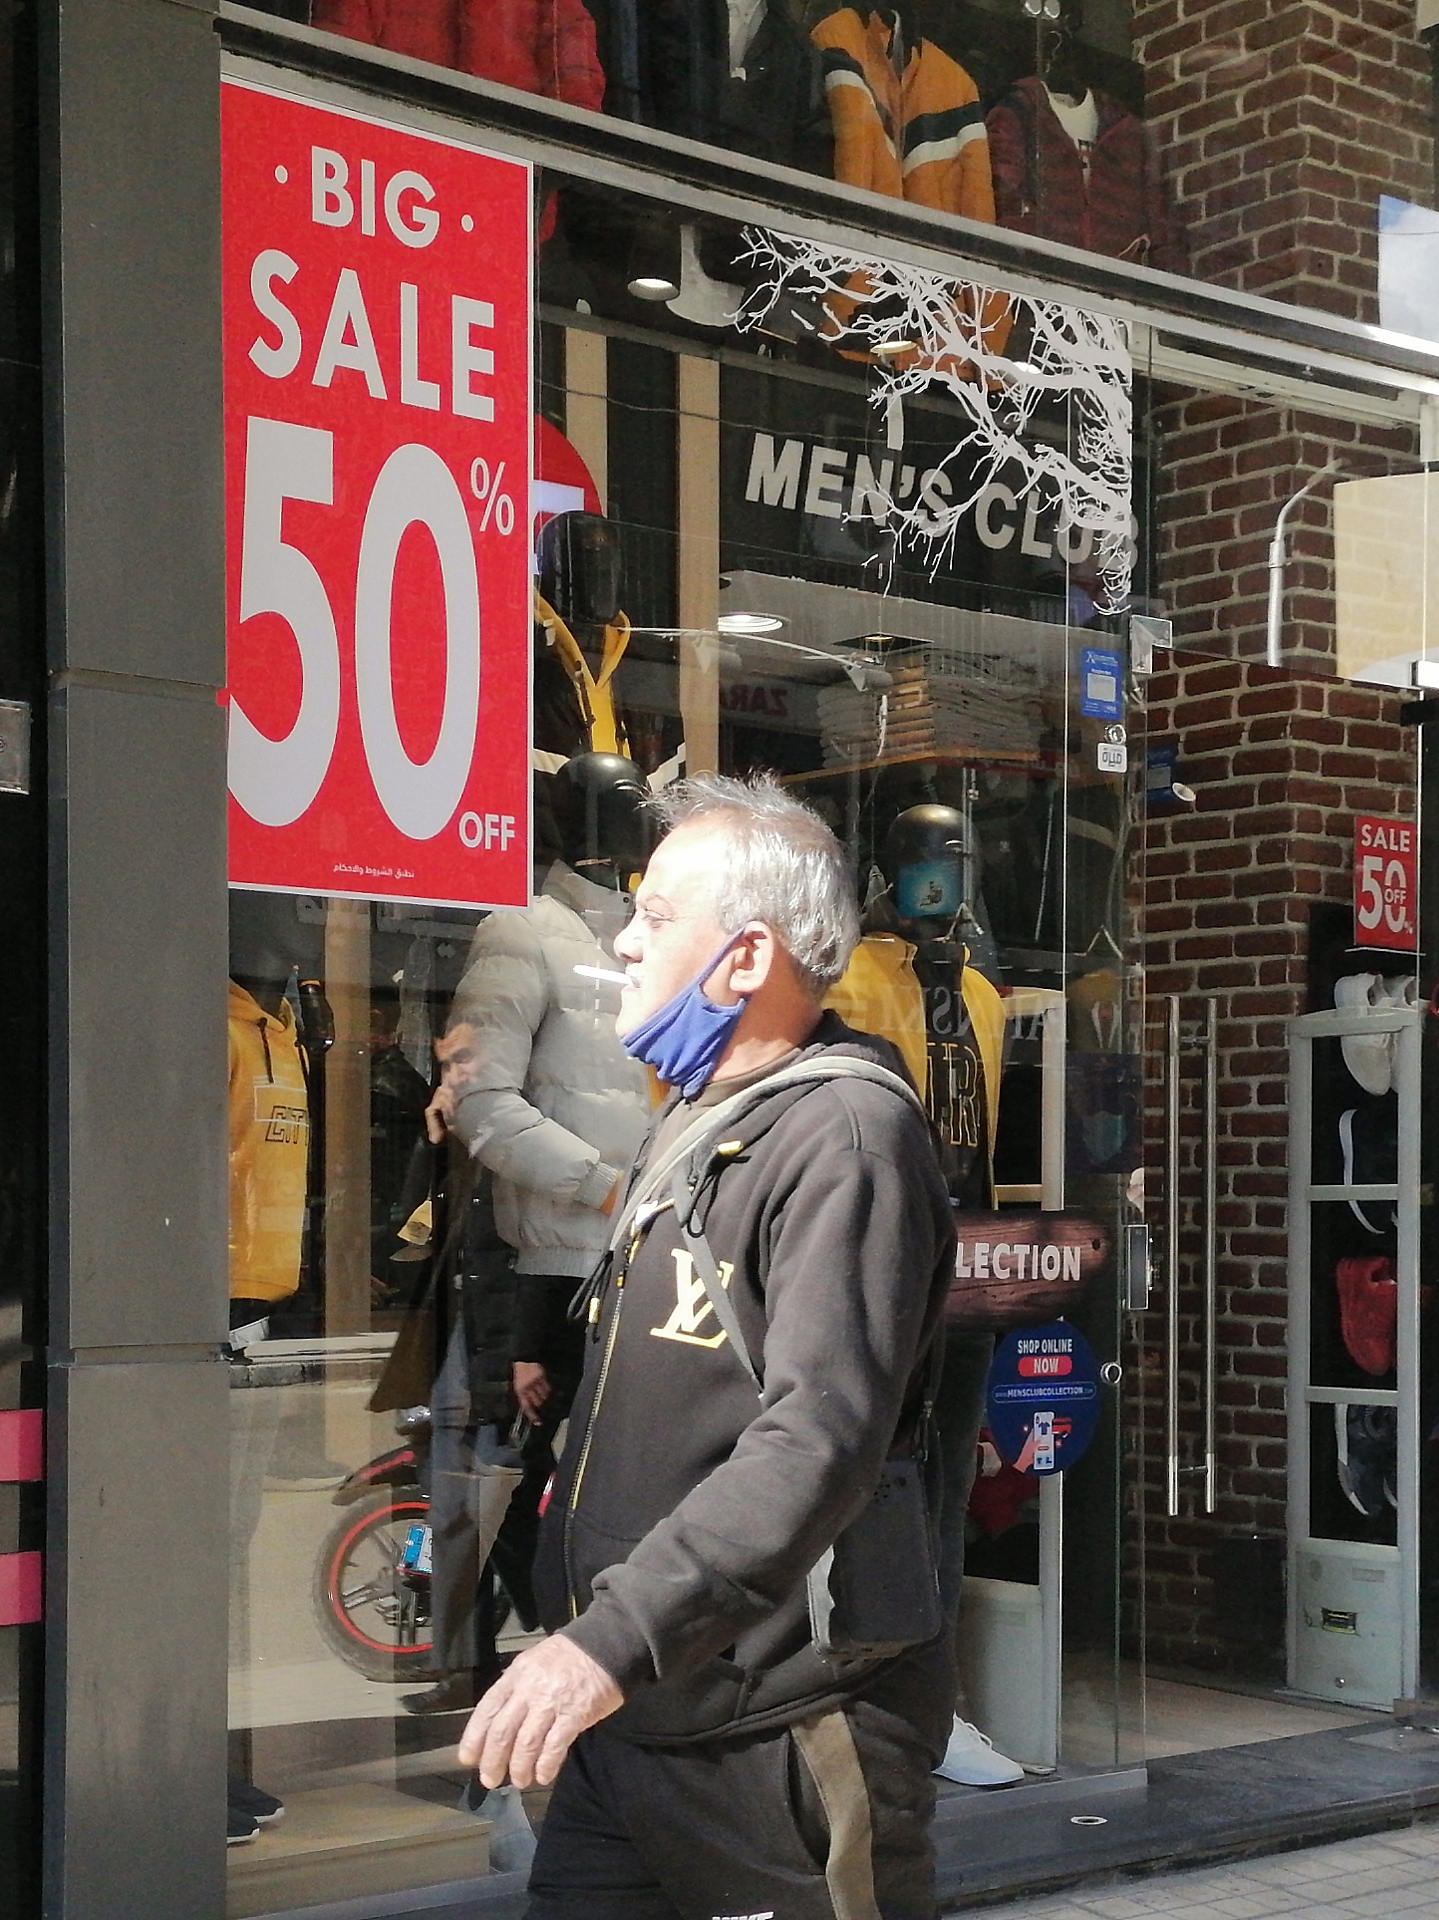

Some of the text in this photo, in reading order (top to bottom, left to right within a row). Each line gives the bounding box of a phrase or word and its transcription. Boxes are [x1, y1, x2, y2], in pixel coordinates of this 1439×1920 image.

[311, 145, 441, 248] BIG
[247, 249, 495, 422] SALE
[745, 432, 954, 538] MEN'S
[458, 810, 516, 852] OFF
[1361, 823, 1411, 853] SALE
[1384, 888, 1407, 904] OFF
[265, 1105, 307, 1147] CIT
[1017, 1338, 1073, 1355] SHOP ONLINE
[1033, 1358, 1059, 1374] NOW
